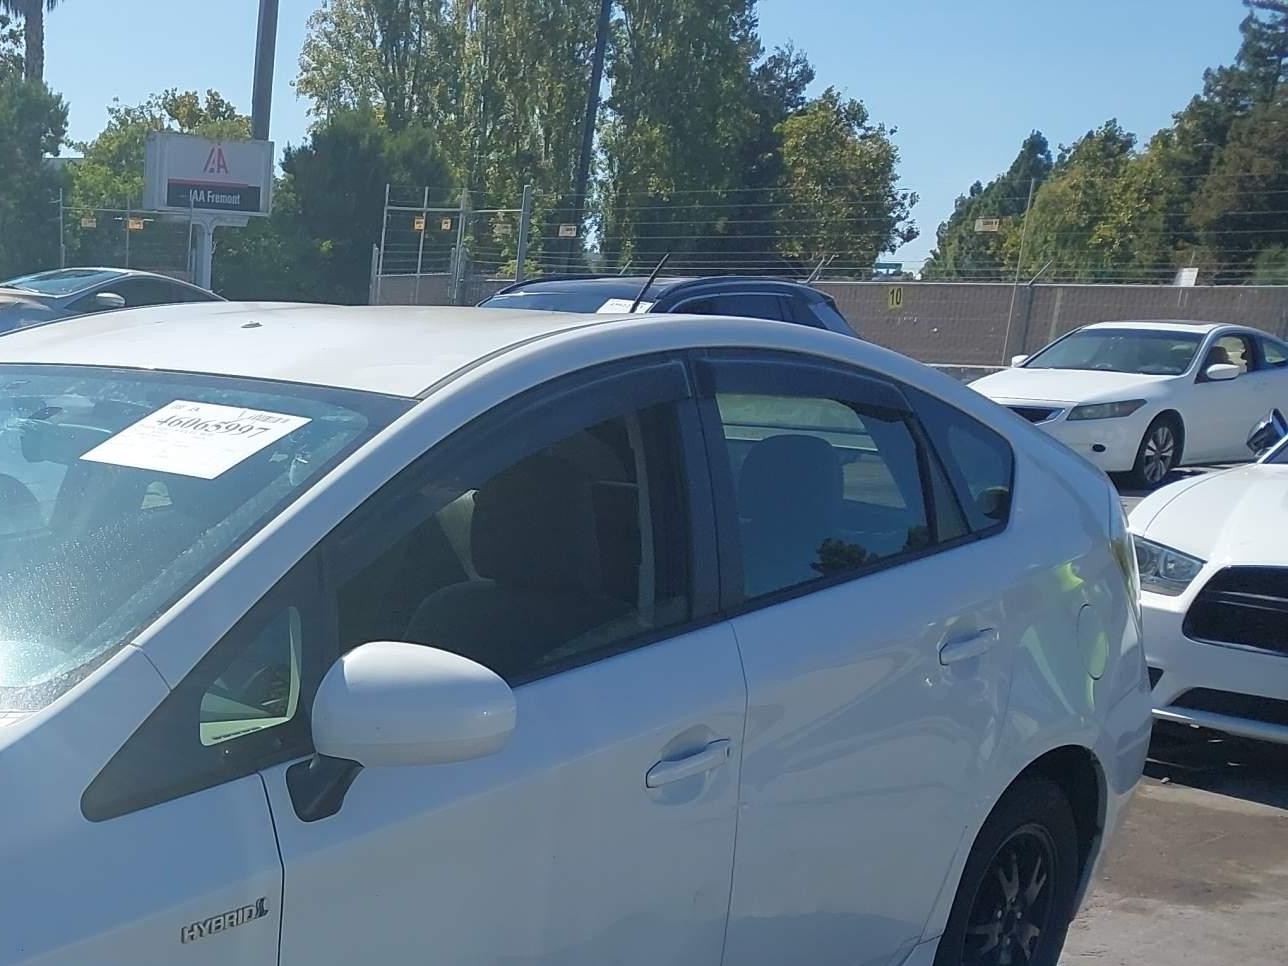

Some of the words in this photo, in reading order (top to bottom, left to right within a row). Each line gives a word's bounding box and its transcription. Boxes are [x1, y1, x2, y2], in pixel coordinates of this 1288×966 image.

[189, 188, 206, 202] IAA
[207, 190, 241, 205] Fremont
[890, 288, 902, 305] 10
[157, 415, 271, 438] 46065997
[181, 904, 257, 944] HYBRID
